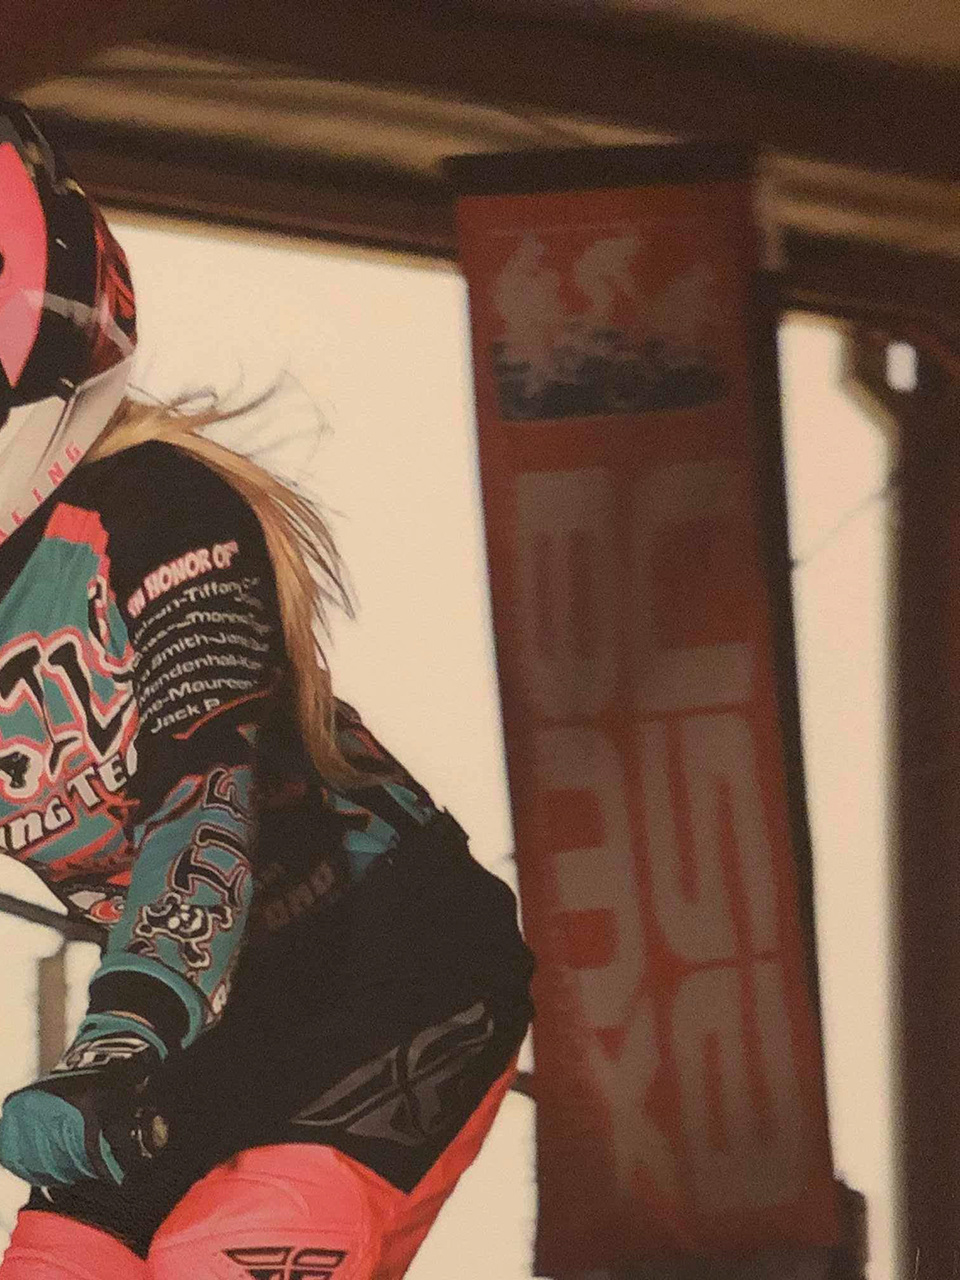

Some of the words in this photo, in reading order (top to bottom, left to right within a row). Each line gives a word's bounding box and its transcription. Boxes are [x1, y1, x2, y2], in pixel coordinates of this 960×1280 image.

[143, 548, 213, 601] HONOR
[212, 540, 239, 570] OF
[150, 704, 201, 735] Jack
[66, 741, 138, 808] TE
